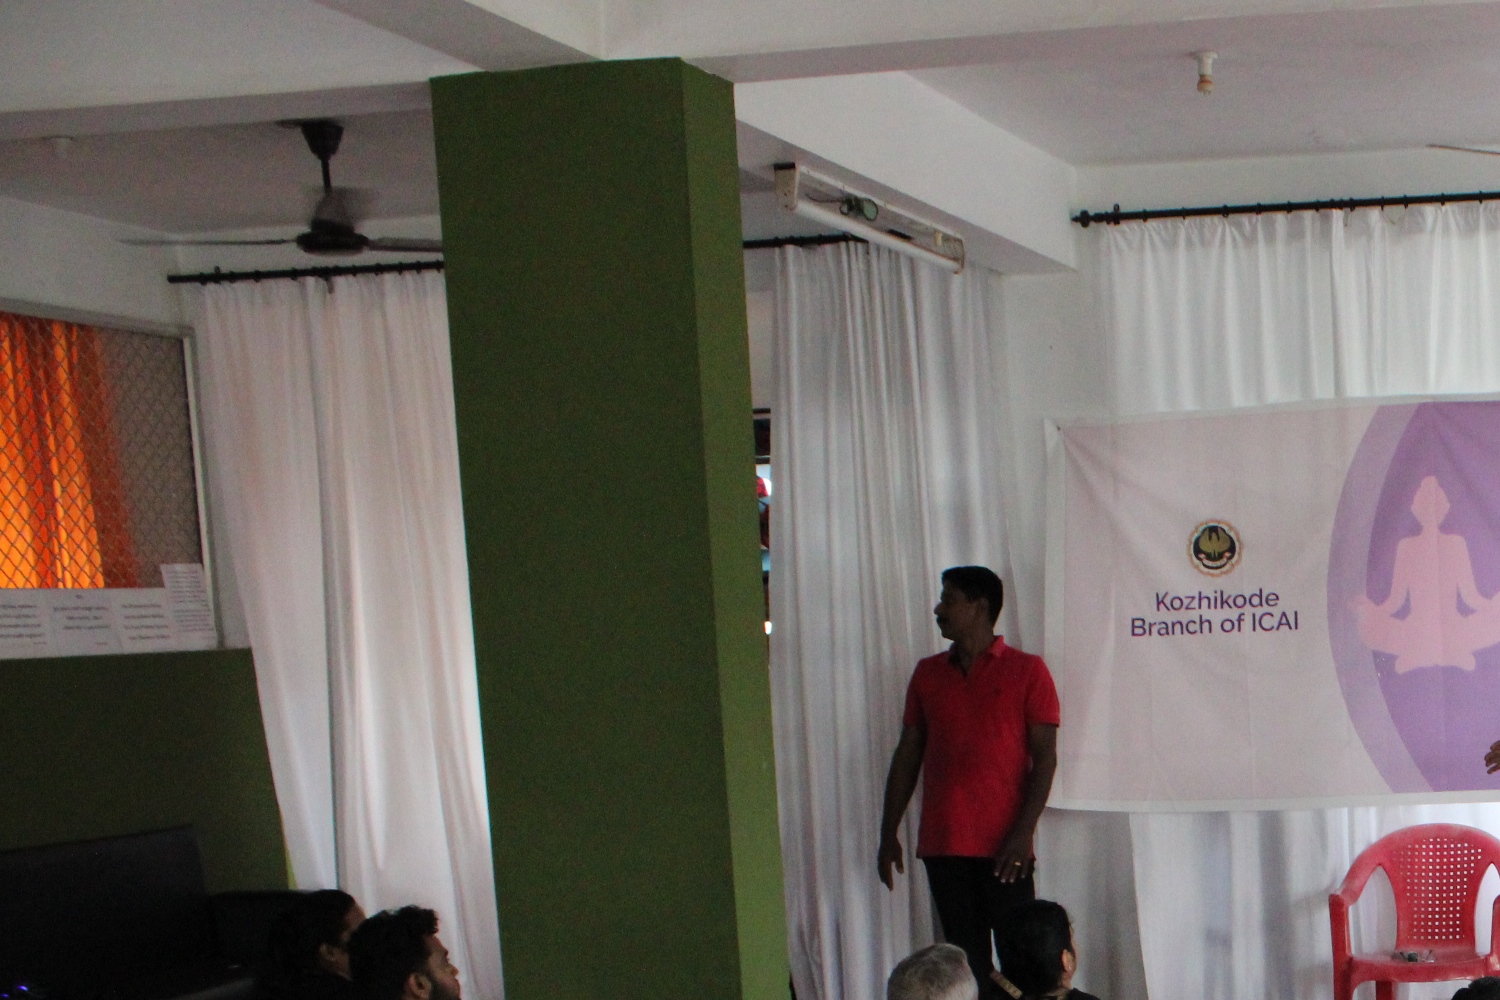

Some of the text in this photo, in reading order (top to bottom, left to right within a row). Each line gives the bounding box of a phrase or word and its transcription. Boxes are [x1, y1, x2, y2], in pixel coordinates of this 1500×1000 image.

[1156, 588, 1279, 611] Kozhikode
[1131, 611, 1299, 637] Branch of ICAI
